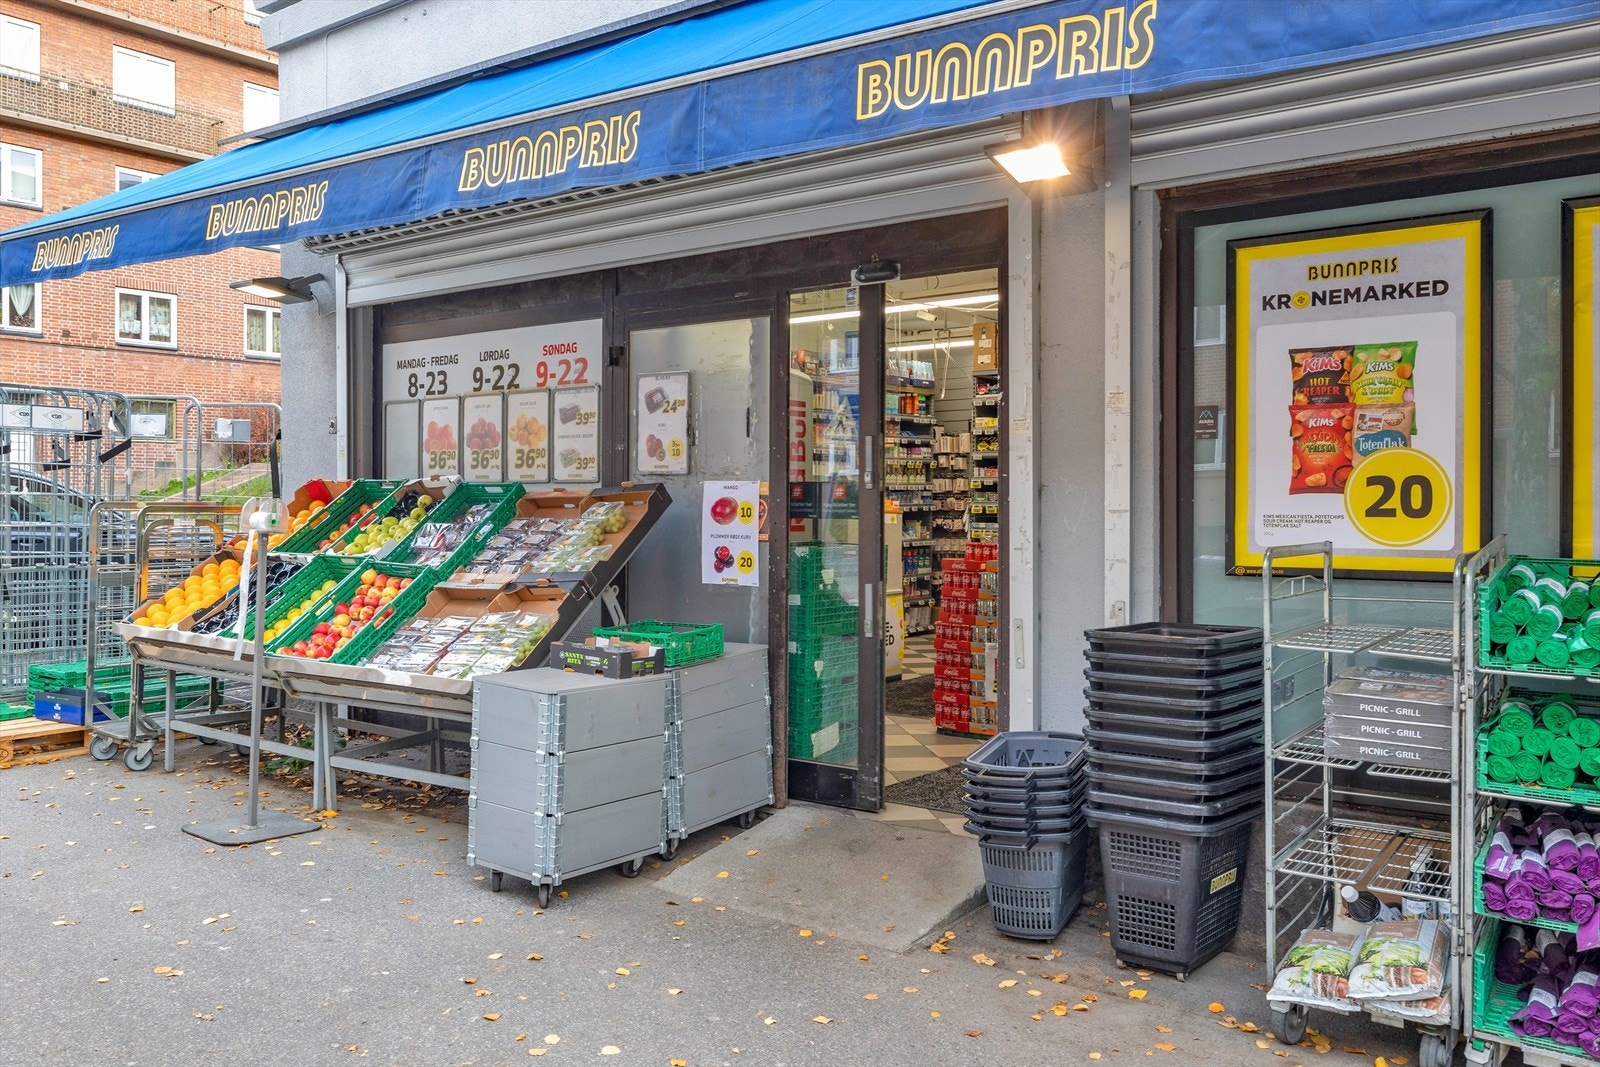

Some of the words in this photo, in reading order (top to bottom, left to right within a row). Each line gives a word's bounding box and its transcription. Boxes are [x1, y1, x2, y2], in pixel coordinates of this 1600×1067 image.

[856, 0, 1157, 120] BUNNPRIS
[458, 110, 641, 192] BUNNPRIS
[206, 180, 328, 240] BUNNPRIS
[31, 224, 119, 271] BUNNPRIS
[1308, 257, 1398, 281] BUNNPRIS
[479, 349, 510, 362] LØRDAG
[542, 342, 578, 356] SØNDAG
[396, 357, 426, 370] MANDAG
[431, 354, 459, 367] FREDAG
[472, 363, 520, 393] 9-22
[536, 357, 589, 387] 9-22
[408, 370, 448, 398] 8-23
[1309, 377, 1331, 386] HOT
[1303, 386, 1340, 396] REAPER
[1359, 437, 1405, 451] Totenflak
[1364, 474, 1433, 518] 20
[740, 507, 752, 518] 10
[740, 557, 752, 568] 20
[564, 651, 584, 660] SANTA
[566, 657, 582, 665] RITA
[1360, 703, 1389, 713] PICNIC
[1395, 707, 1421, 717] GRILL
[1361, 725, 1390, 735] PICNIC
[1396, 729, 1422, 738] GRILL
[1360, 746, 1389, 756] PICNIC
[1395, 750, 1421, 760] GRILL
